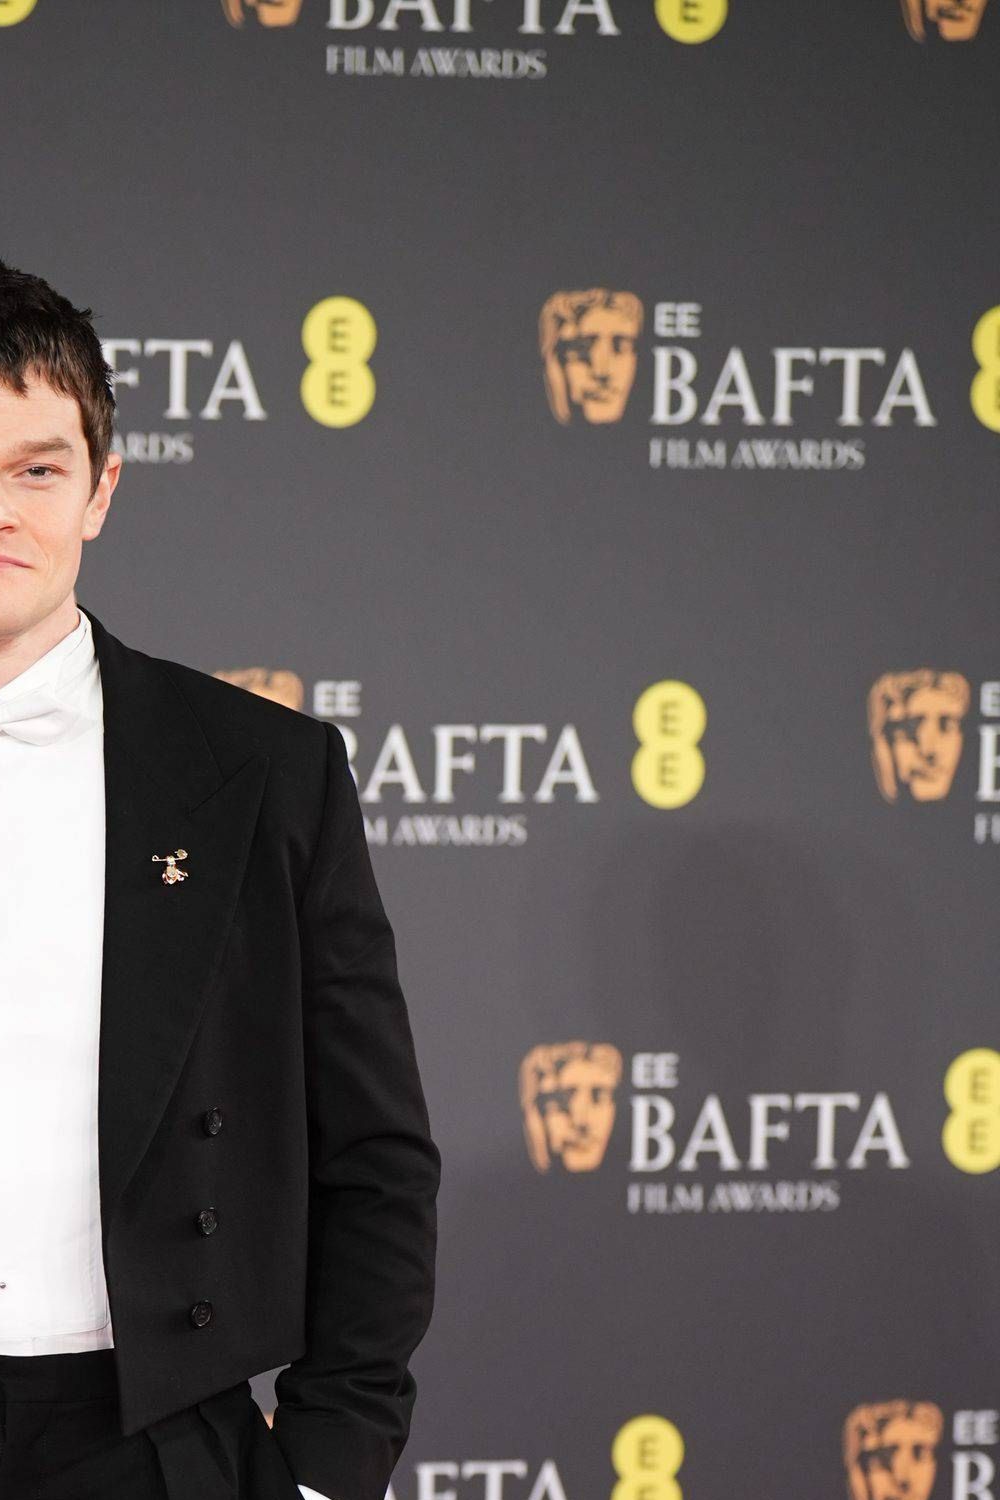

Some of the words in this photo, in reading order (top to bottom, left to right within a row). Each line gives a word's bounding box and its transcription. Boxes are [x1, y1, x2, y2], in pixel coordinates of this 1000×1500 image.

[325, 44, 405, 76] FILM
[410, 47, 547, 79] AWARDS
[653, 301, 702, 338] EE
[101, 337, 267, 421] FTA
[650, 346, 936, 427] BAFTA
[649, 437, 727, 469] FILM
[731, 438, 866, 470] AWARDS
[313, 680, 361, 717] EE
[392, 814, 528, 846] AWARDS
[631, 1052, 679, 1089] EE
[629, 1092, 909, 1172] BAFTA
[627, 1183, 704, 1214] FILM
[709, 1181, 840, 1212] AWARDS
[952, 1409, 999, 1446] EE
